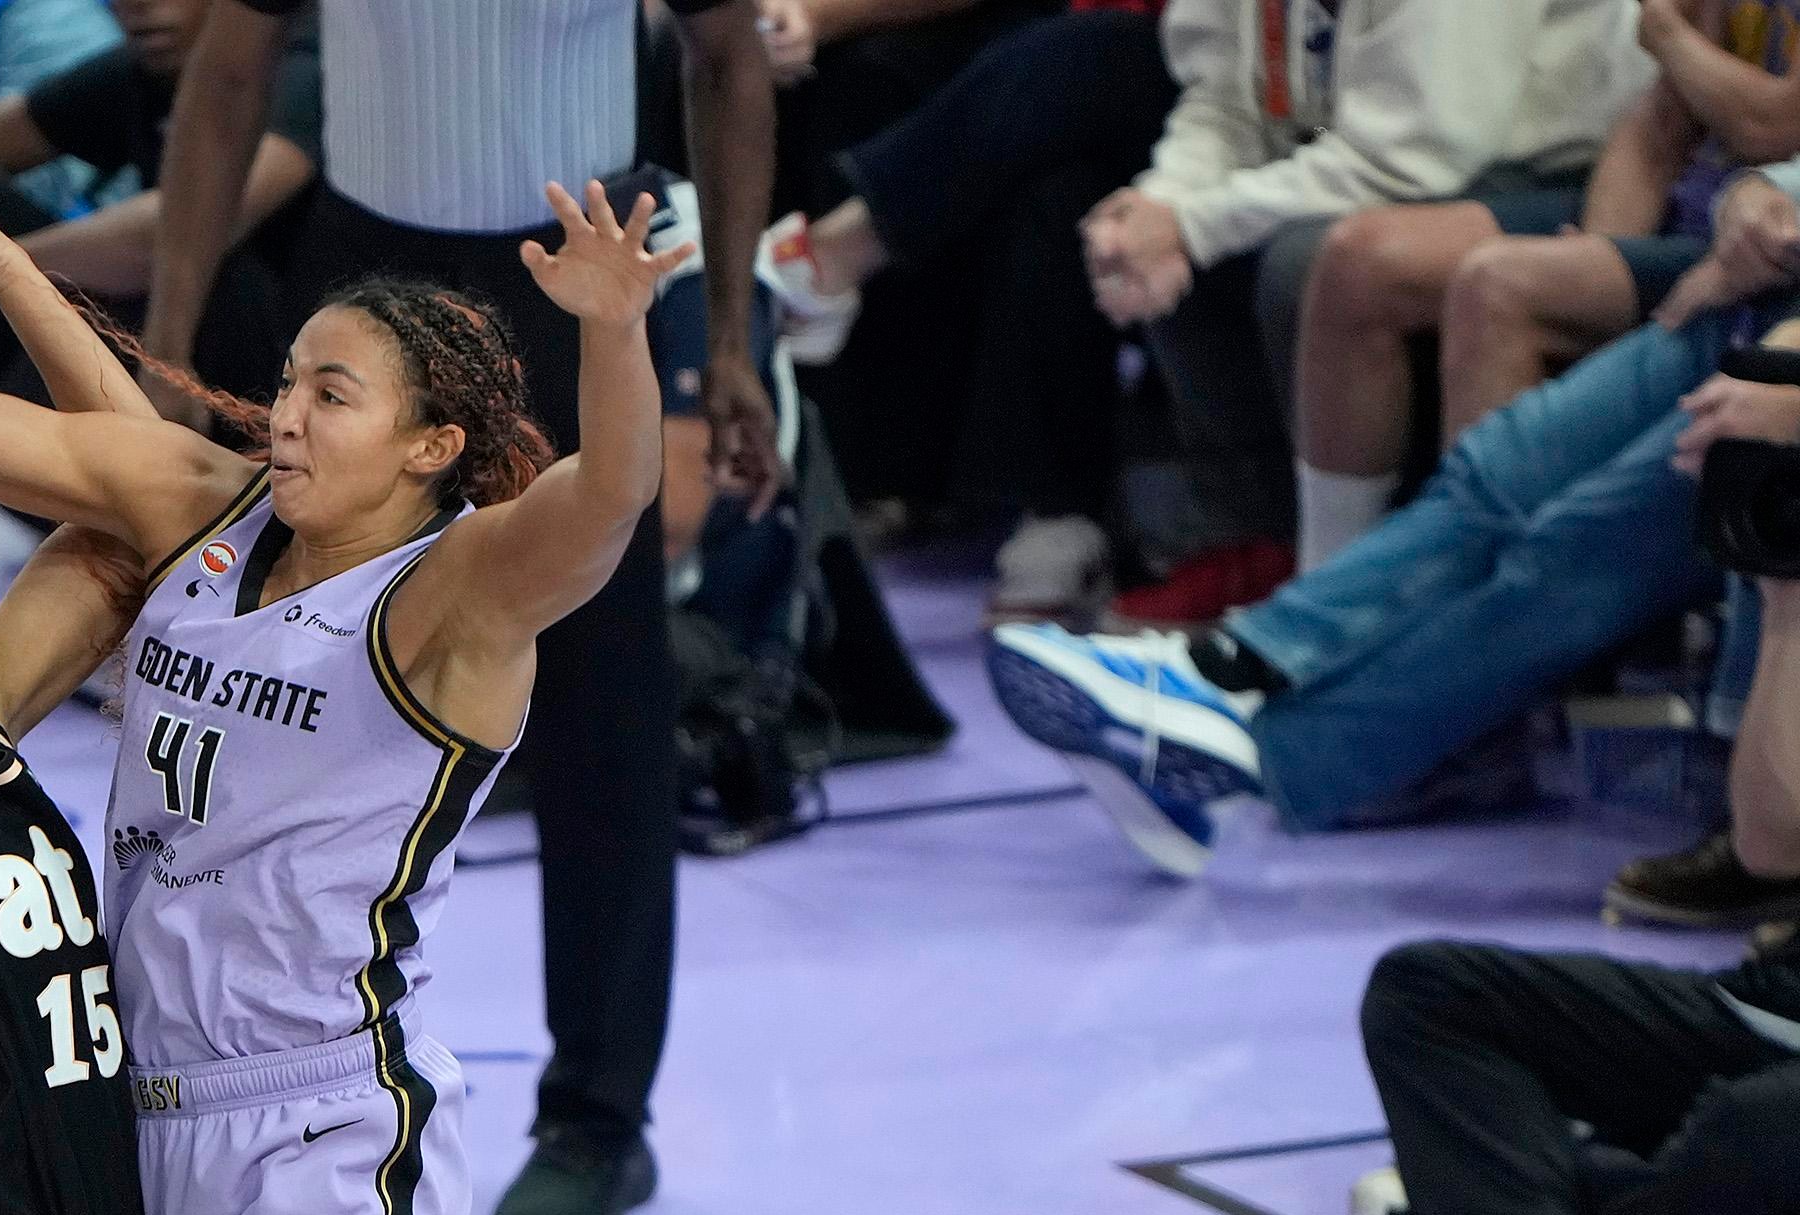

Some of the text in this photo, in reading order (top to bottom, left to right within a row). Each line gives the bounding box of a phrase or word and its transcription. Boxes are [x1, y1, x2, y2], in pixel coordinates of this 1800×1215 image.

[135, 635, 328, 733] GDEN STATE
[144, 710, 226, 826] 41
[150, 864, 225, 889] MANENTE
[36, 964, 123, 1089] 15
[137, 1074, 182, 1111] GSV
